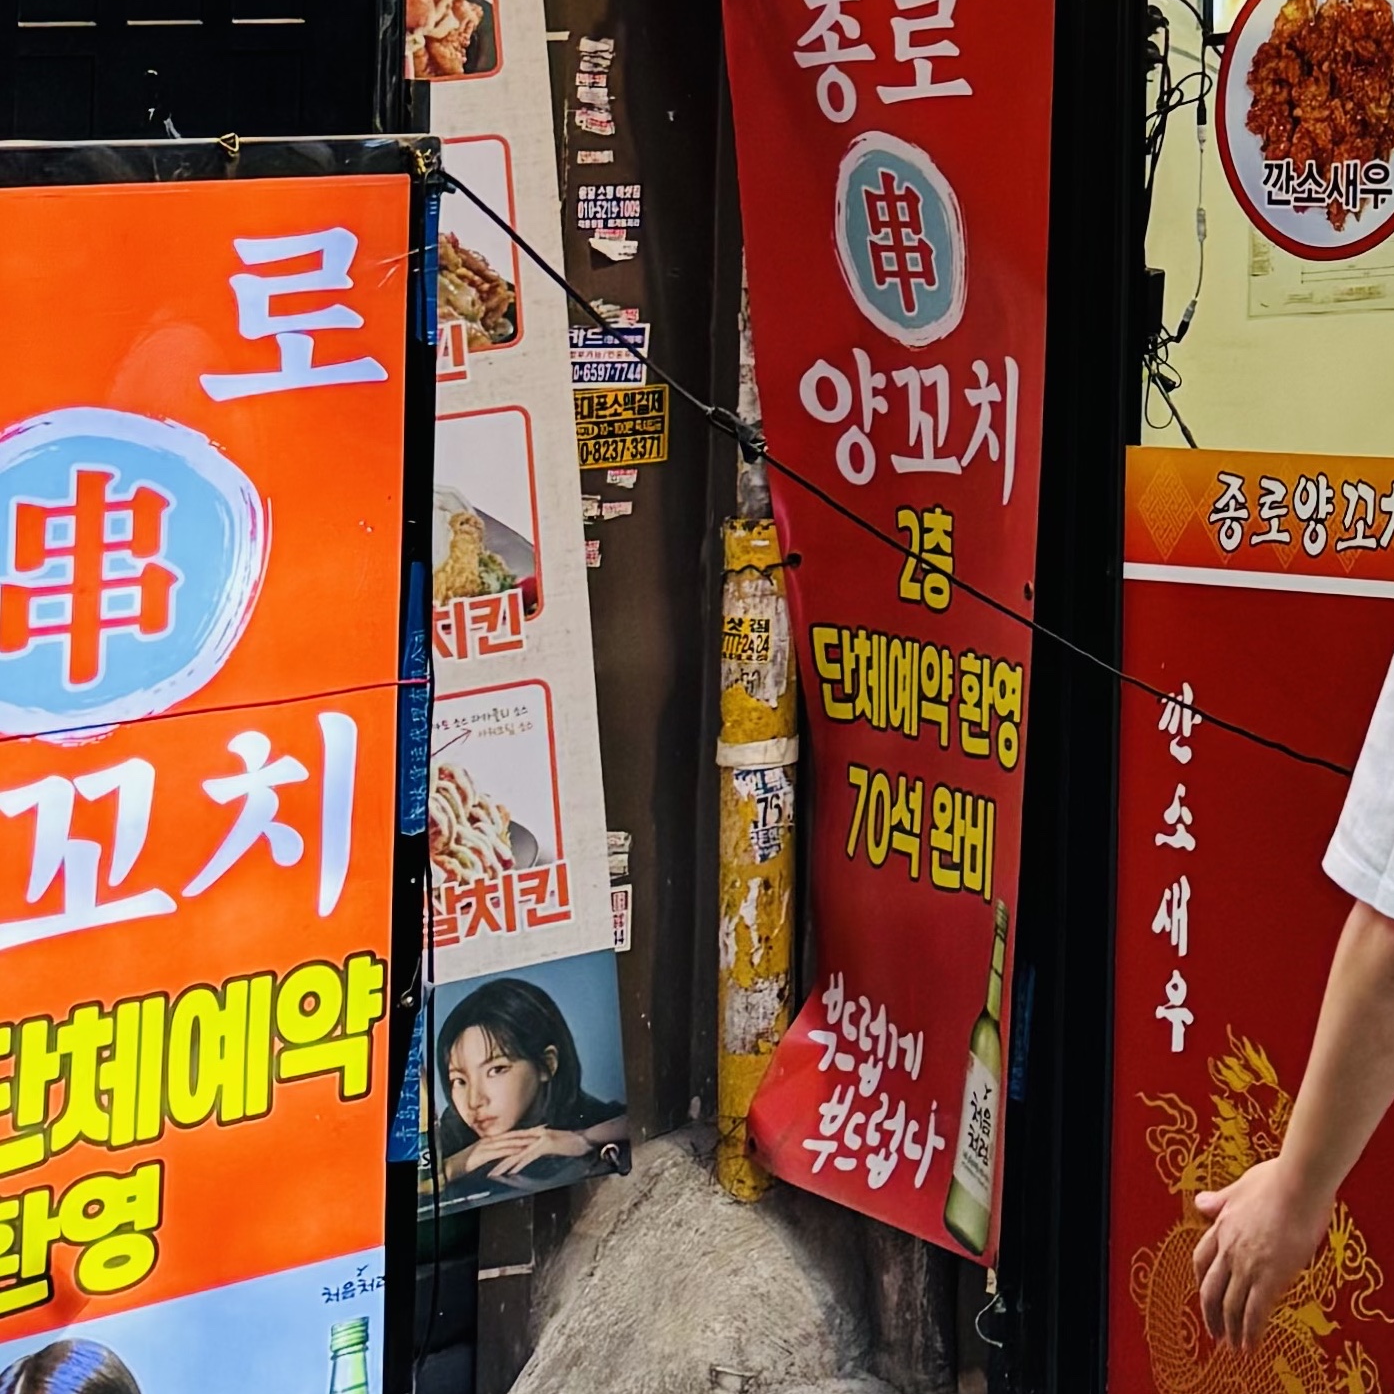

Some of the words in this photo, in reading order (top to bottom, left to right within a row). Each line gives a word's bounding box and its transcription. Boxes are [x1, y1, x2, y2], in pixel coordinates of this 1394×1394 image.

[863, 170, 937, 313] 串
[1262, 159, 1394, 209] 깐소새우
[200, 226, 388, 402] 로
[799, 347, 1020, 506] 양꼬치
[0, 466, 172, 686] 串
[896, 504, 954, 613] 2층
[811, 623, 953, 748] 단체예약
[960, 655, 1023, 772] 환영
[0, 711, 358, 952] 꼬치
[847, 765, 922, 884] 70석
[930, 785, 998, 905] 완비
[1152, 682, 1202, 1053] 깐소새우
[807, 970, 924, 1094] 부드럽게
